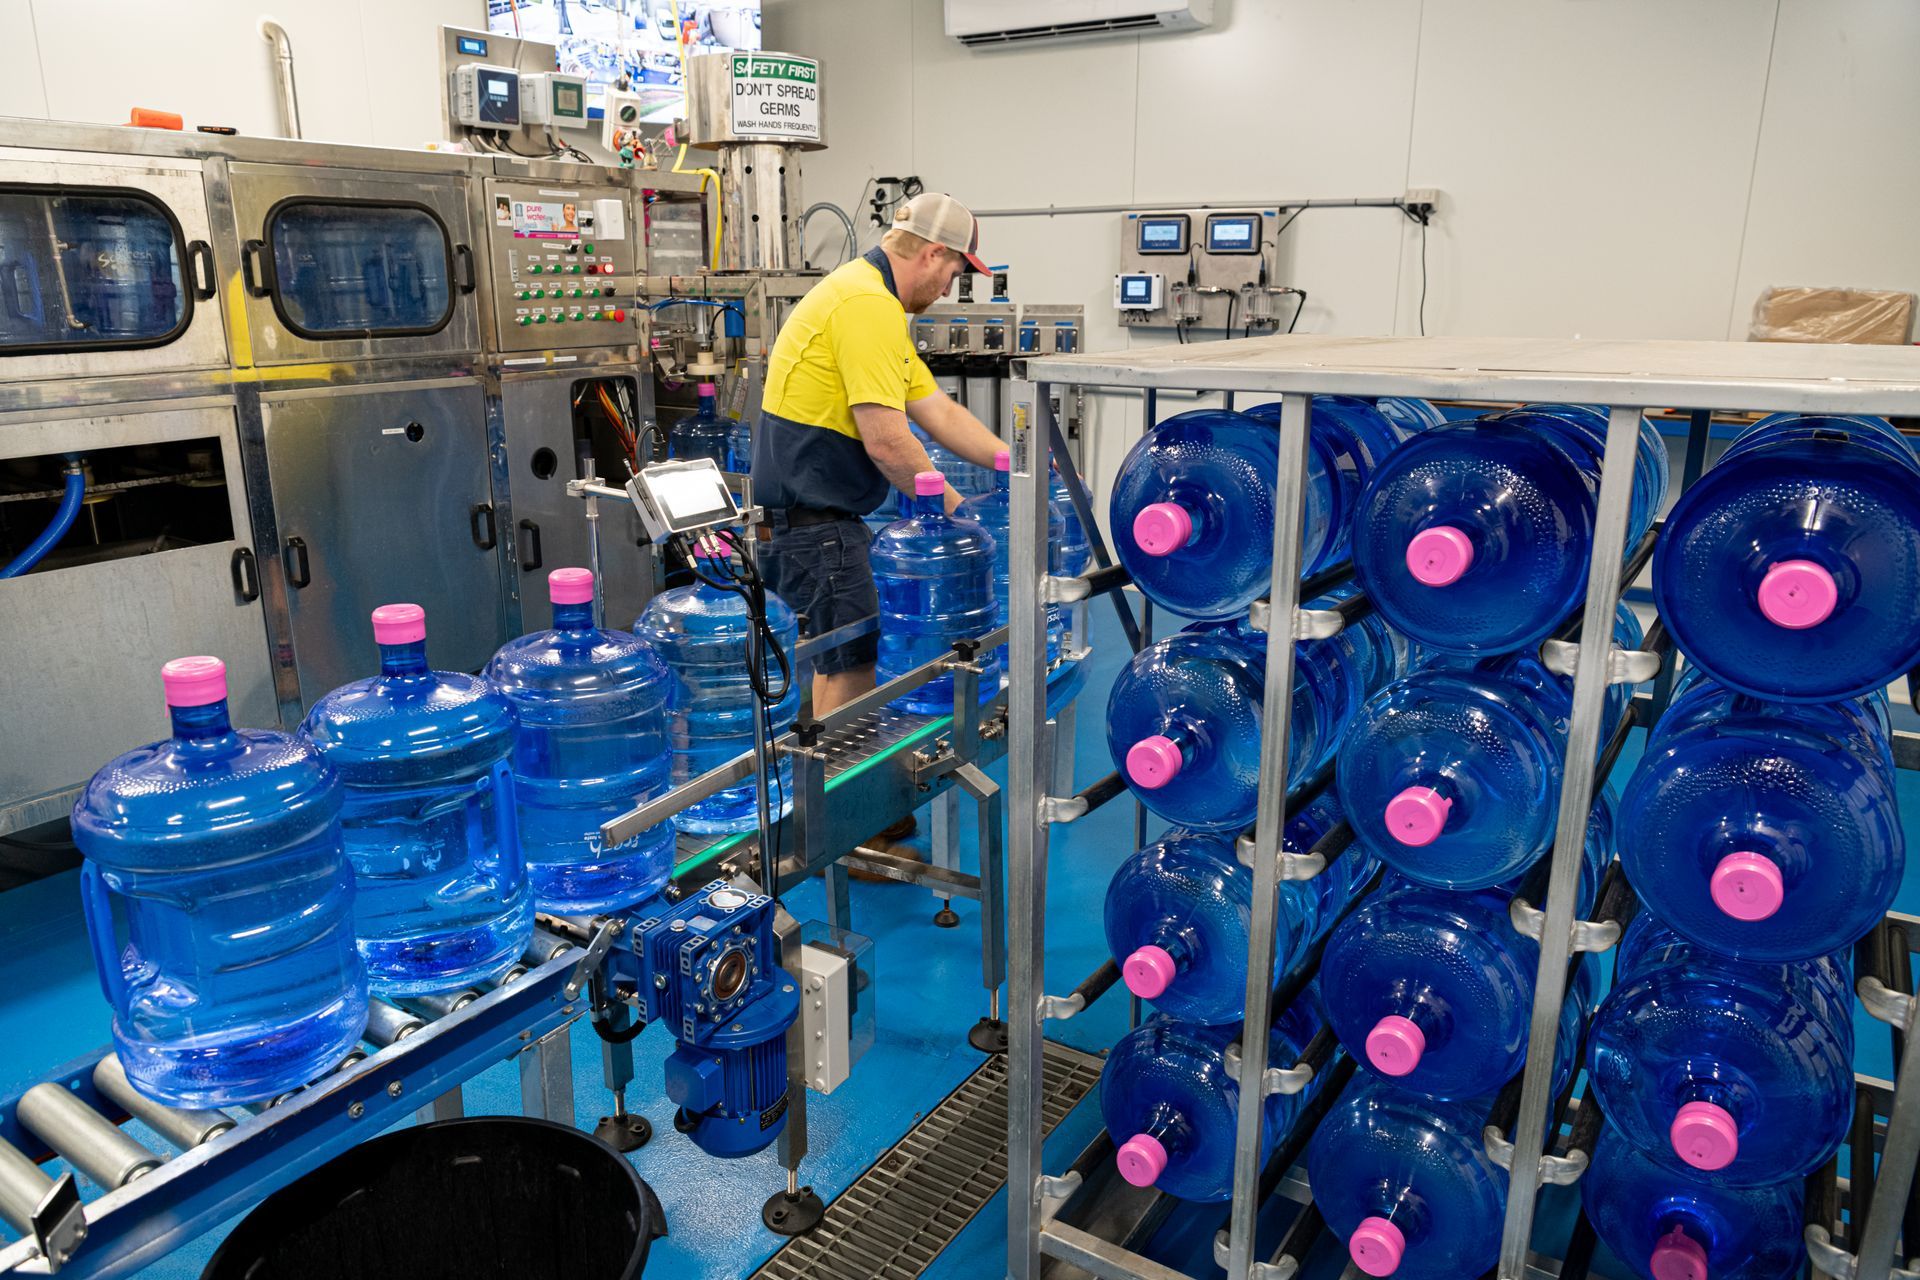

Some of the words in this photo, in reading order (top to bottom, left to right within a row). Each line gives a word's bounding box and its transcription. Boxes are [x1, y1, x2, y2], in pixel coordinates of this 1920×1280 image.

[735, 61, 786, 75] SAFETY
[788, 64, 816, 79] FIRST
[736, 82, 773, 96] DON'T
[777, 84, 816, 101] SPREAD
[760, 102, 800, 117] GERMS
[737, 120, 757, 128] WASH
[758, 121, 782, 129] HANDS
[526, 205, 542, 213] pure
